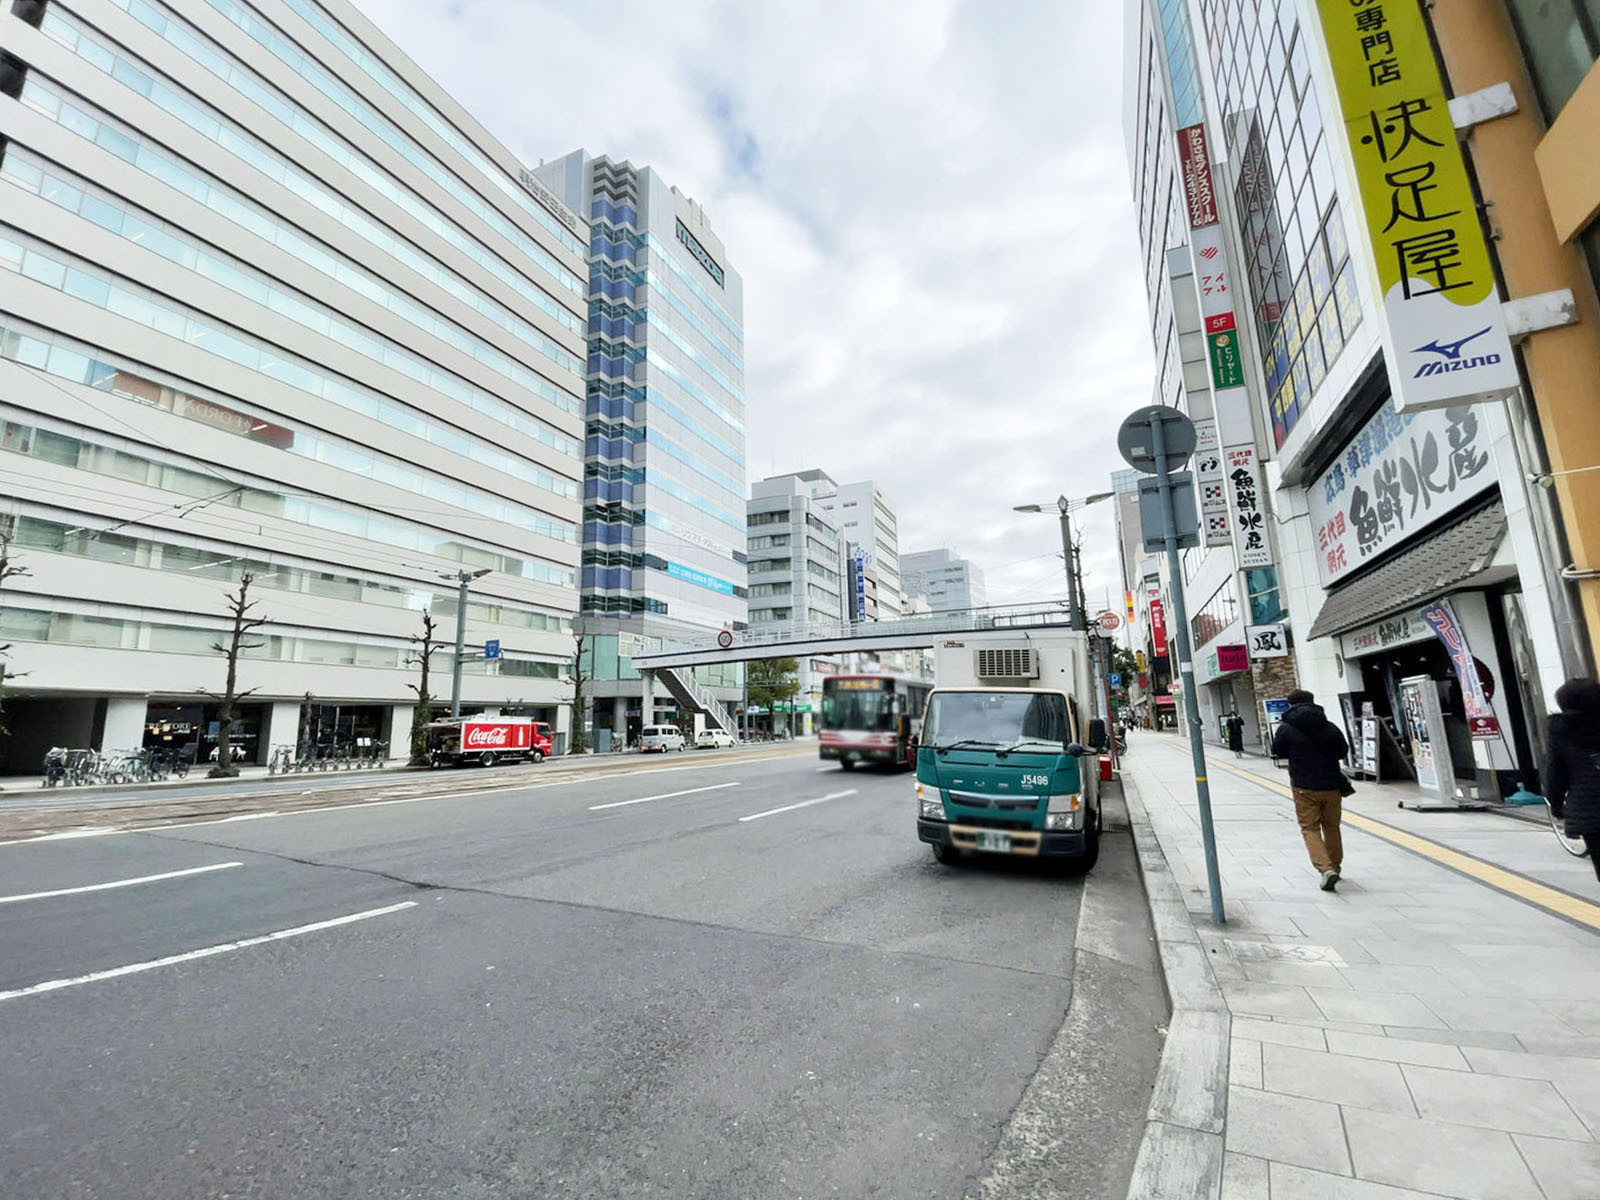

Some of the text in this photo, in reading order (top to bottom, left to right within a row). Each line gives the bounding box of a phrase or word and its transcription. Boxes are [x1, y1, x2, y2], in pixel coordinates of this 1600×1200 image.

[1361, 98, 1474, 300] 快足屋
[1212, 317, 1228, 329] 5F
[1318, 510, 1347, 551] 三代目
